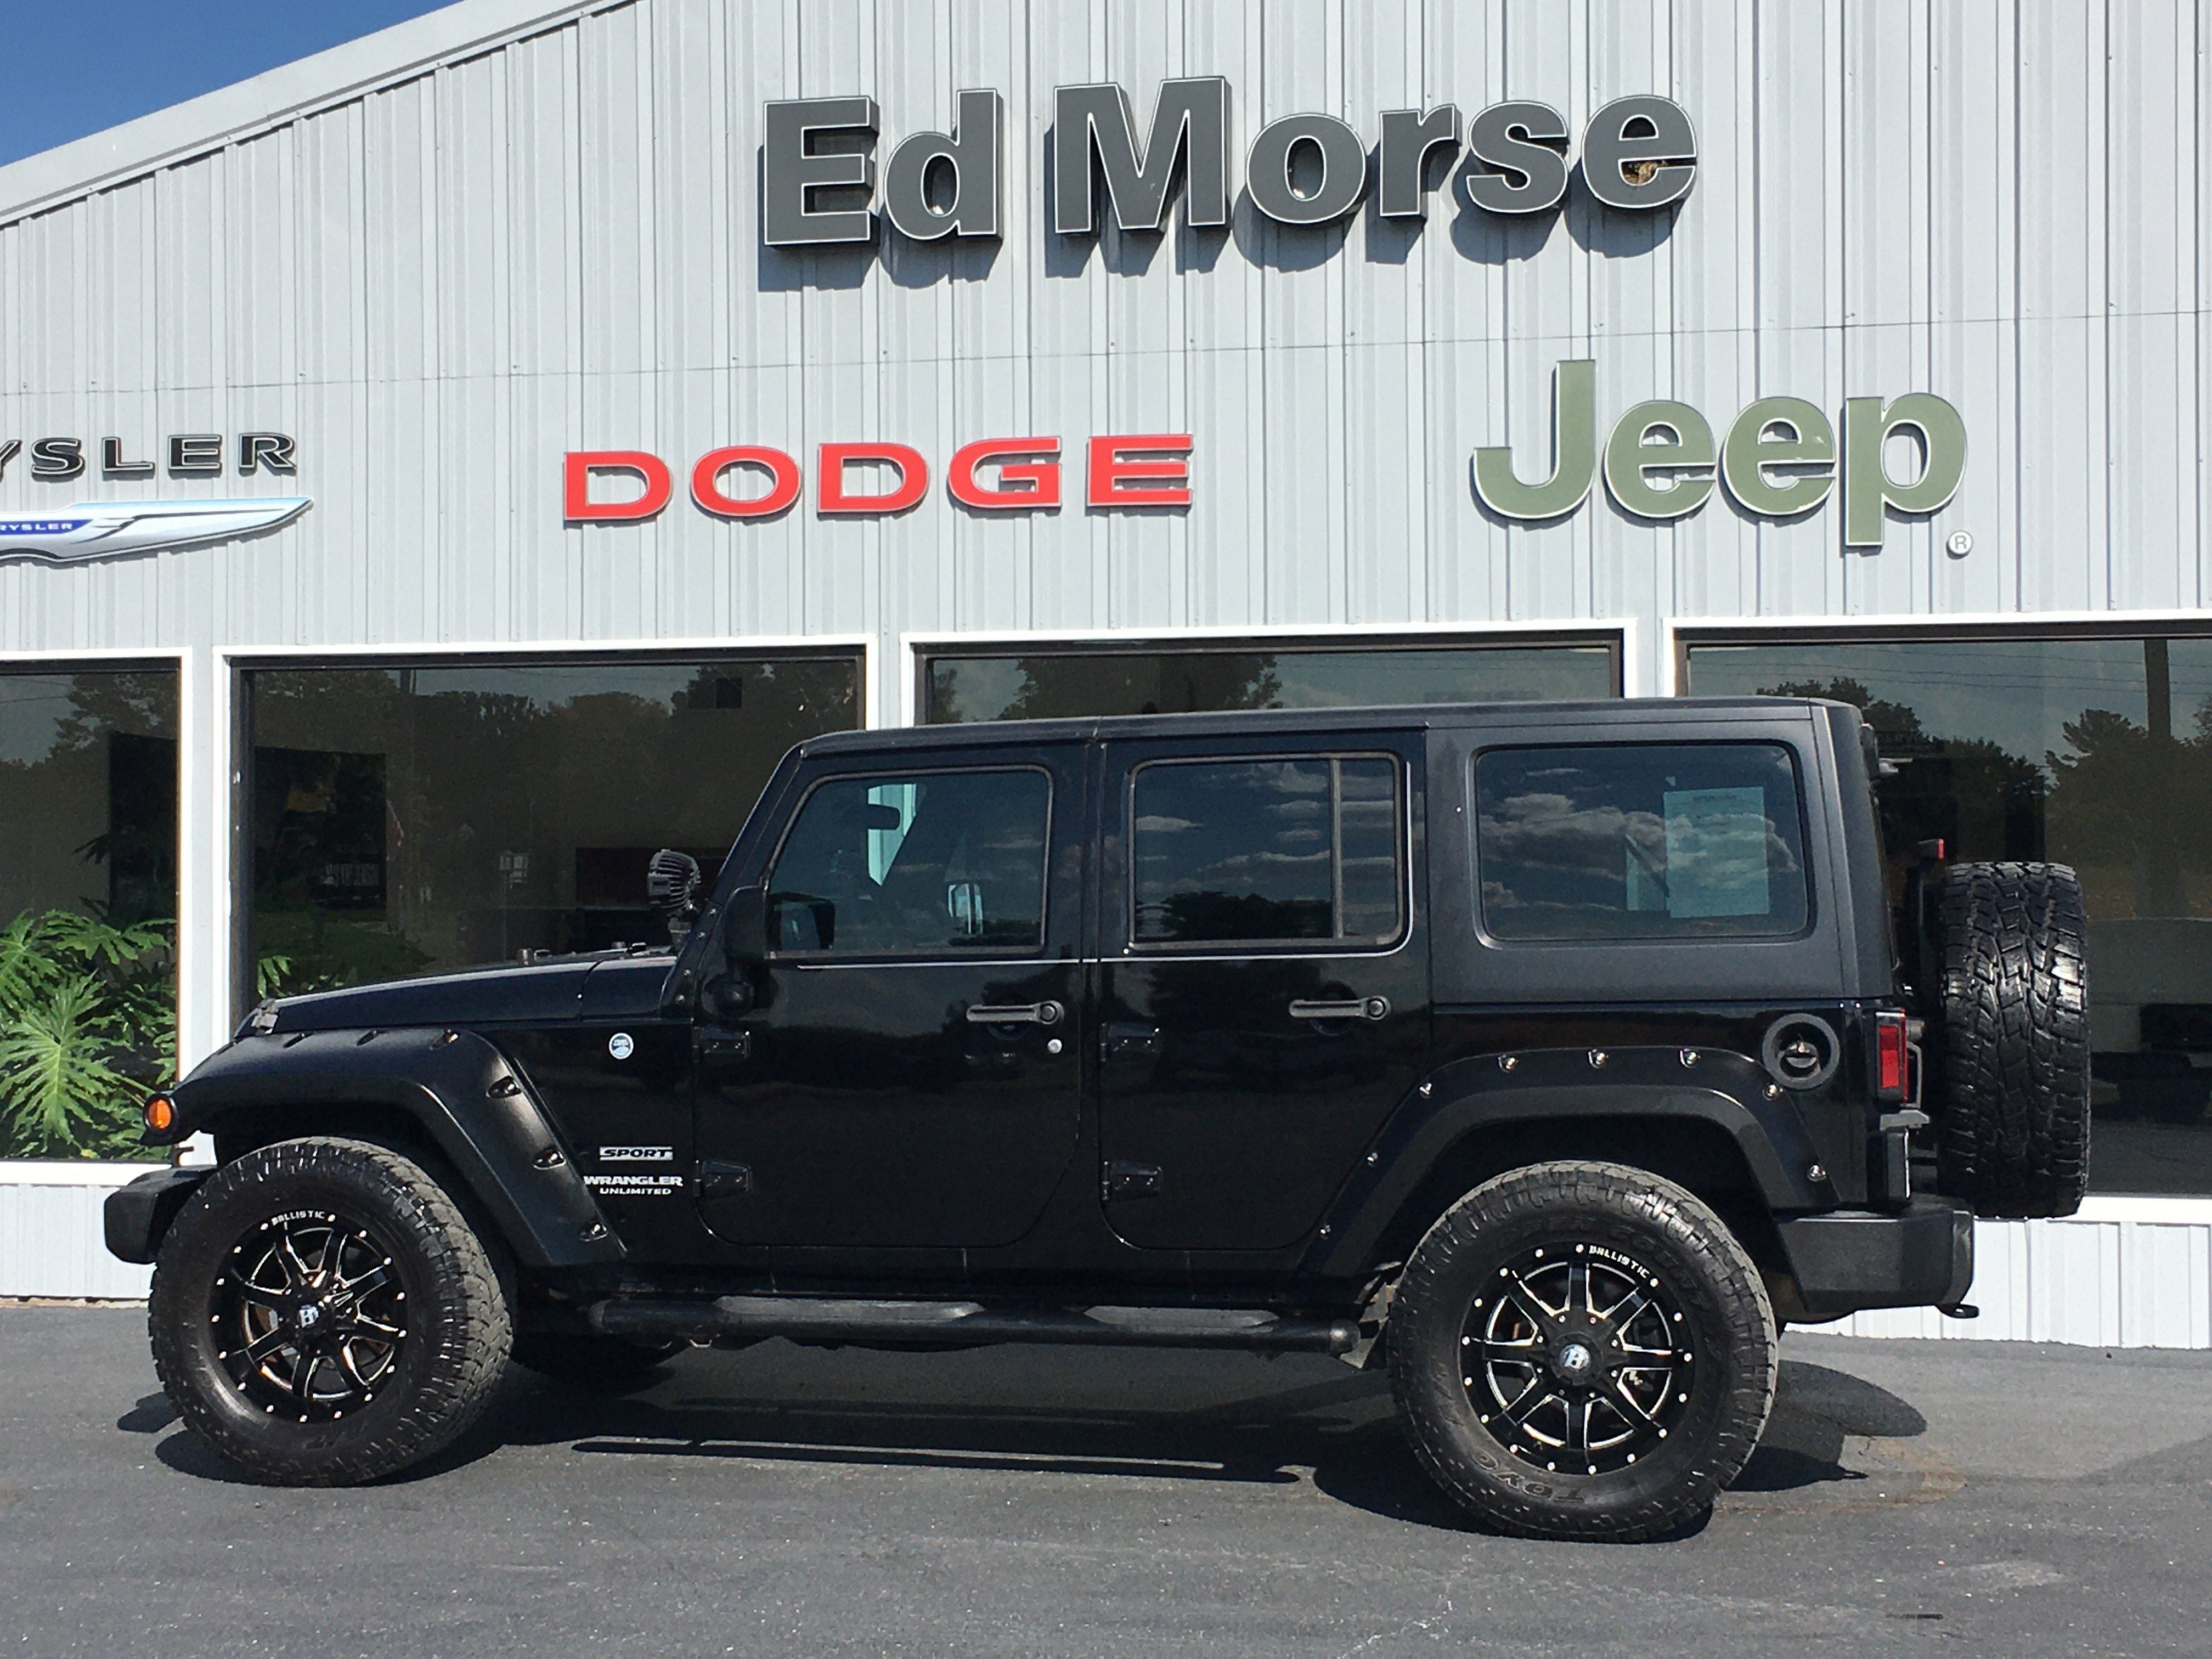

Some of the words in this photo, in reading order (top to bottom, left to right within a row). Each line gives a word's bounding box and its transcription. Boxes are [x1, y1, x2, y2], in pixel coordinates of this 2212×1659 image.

[763, 87, 1001, 246] Ed
[1053, 75, 1699, 233] Morse
[1471, 358, 1968, 547] Jeep
[563, 433, 1194, 522] DODGE
[601, 1148, 674, 1159] SPORT
[583, 1175, 684, 1187] WRANGLER
[599, 1187, 673, 1195] UNLIMITED
[271, 1210, 325, 1226] BALLISTIC
[1589, 1244, 1650, 1279] BALLISTIC
